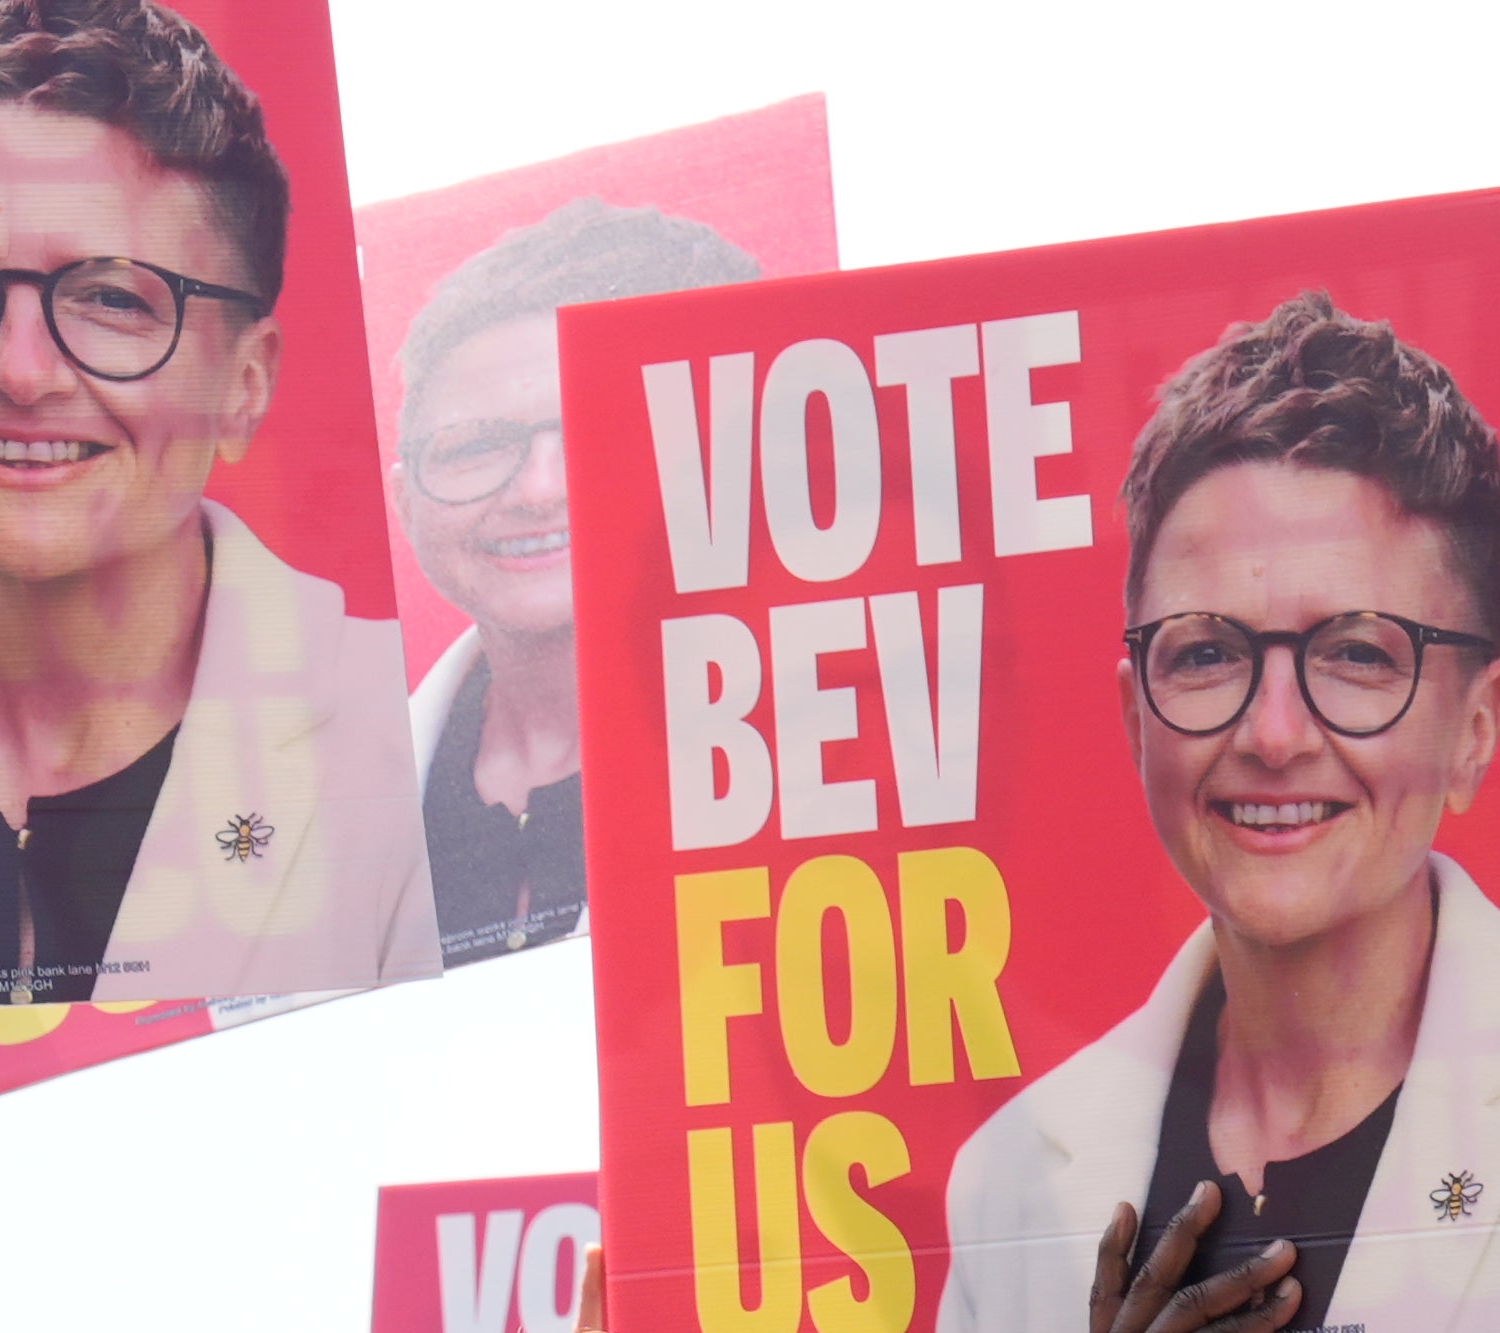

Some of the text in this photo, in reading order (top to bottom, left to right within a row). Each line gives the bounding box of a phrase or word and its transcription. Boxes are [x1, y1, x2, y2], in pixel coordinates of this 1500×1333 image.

[641, 310, 1093, 593] VOTE
[661, 584, 984, 851] BEV
[37, 964, 66, 976] bank
[68, 964, 93, 975] lane
[674, 846, 1022, 1106] FOR
